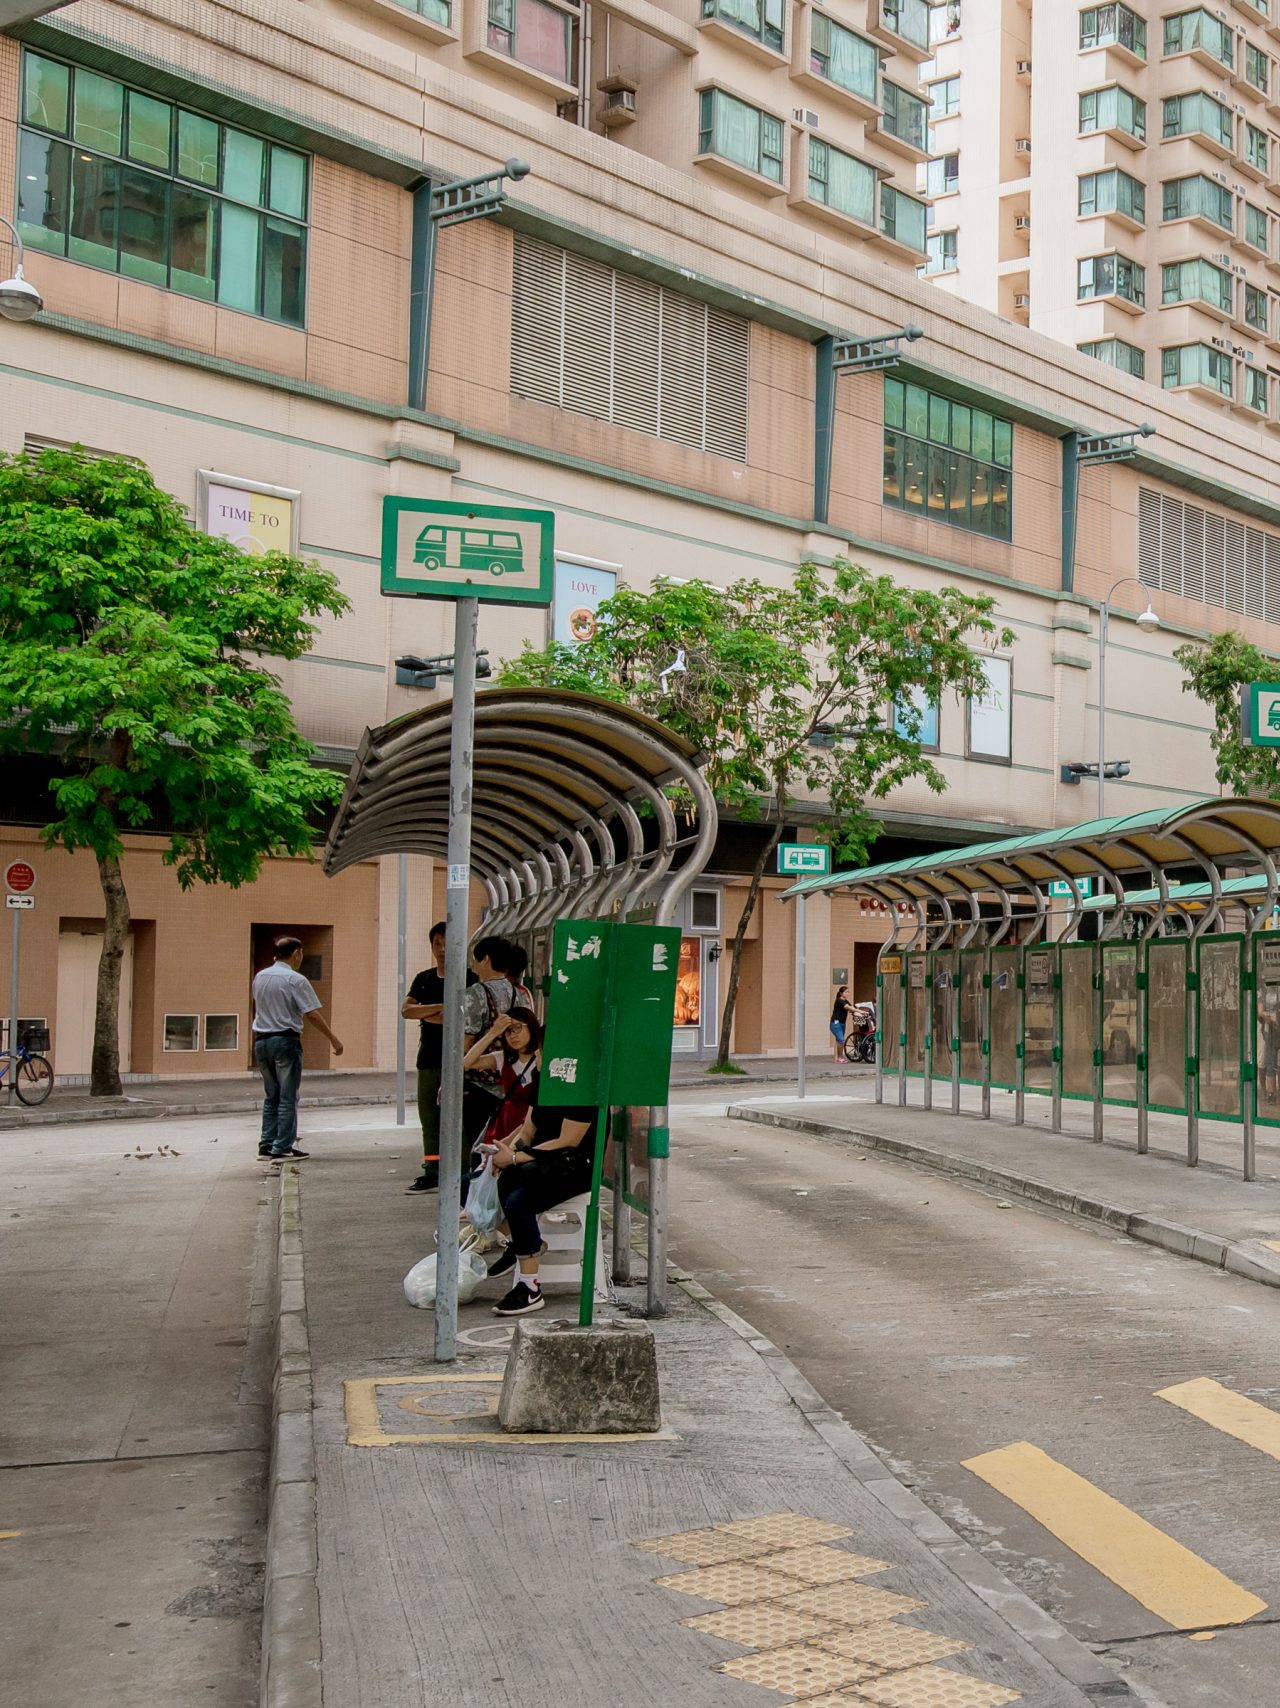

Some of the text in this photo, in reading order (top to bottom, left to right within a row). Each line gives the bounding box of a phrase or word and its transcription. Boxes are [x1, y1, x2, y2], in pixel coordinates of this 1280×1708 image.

[218, 504, 280, 528] TIME TO
[571, 580, 598, 596] LOVE
